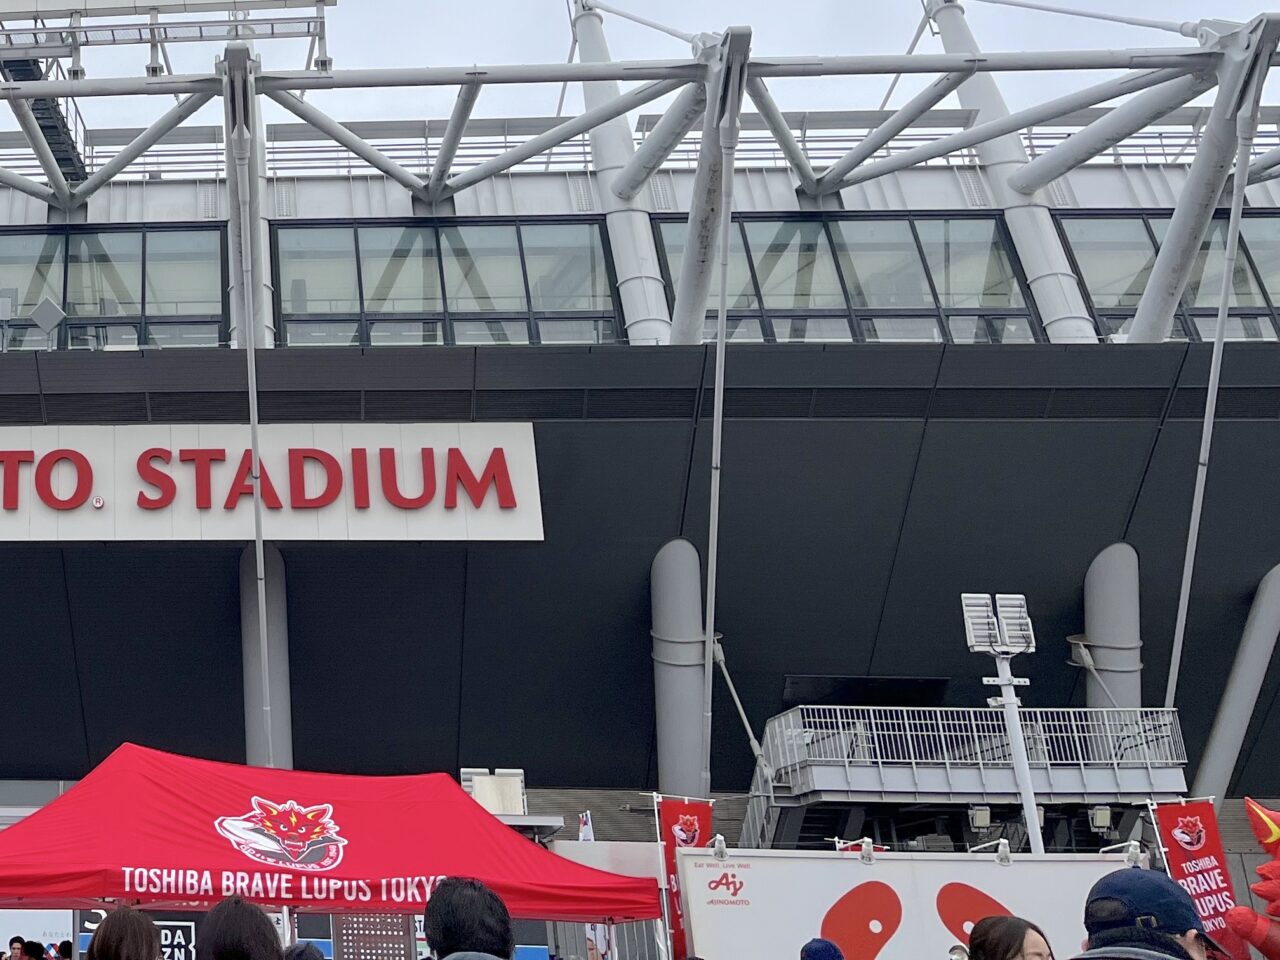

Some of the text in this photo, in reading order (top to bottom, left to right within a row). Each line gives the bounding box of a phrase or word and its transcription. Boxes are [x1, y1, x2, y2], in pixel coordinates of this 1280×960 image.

[136, 447, 517, 510] STADIUM
[1181, 856, 1219, 874] TOSHIBA
[122, 867, 214, 896] TOSHIBA
[222, 871, 293, 899] BRAVE
[301, 875, 371, 902] LUPUS
[1194, 891, 1235, 917] UPUS
